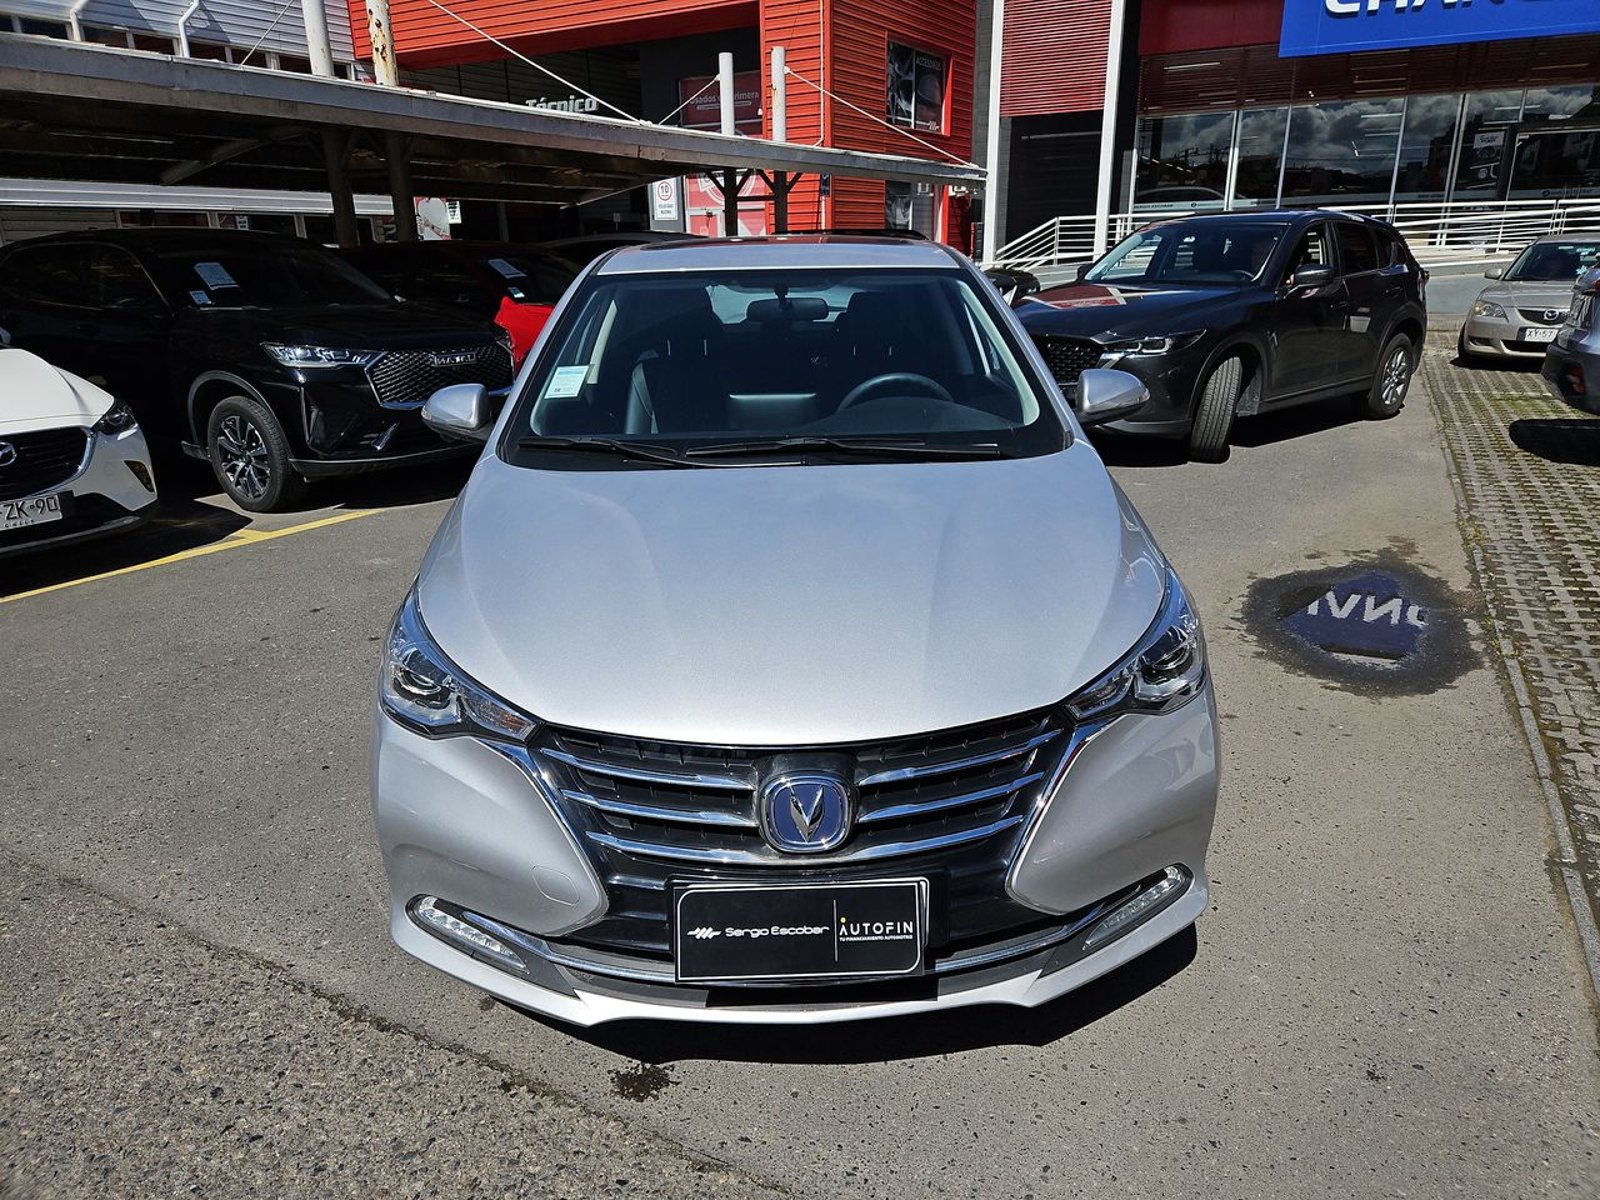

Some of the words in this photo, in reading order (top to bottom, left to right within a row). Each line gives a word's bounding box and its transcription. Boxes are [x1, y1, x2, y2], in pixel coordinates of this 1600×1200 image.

[734, 91, 760, 101] rimera
[660, 184, 669, 194] 10
[725, 927, 770, 938] Sergio
[770, 925, 830, 936] Escobar
[840, 917, 913, 935] AUTOFIN
